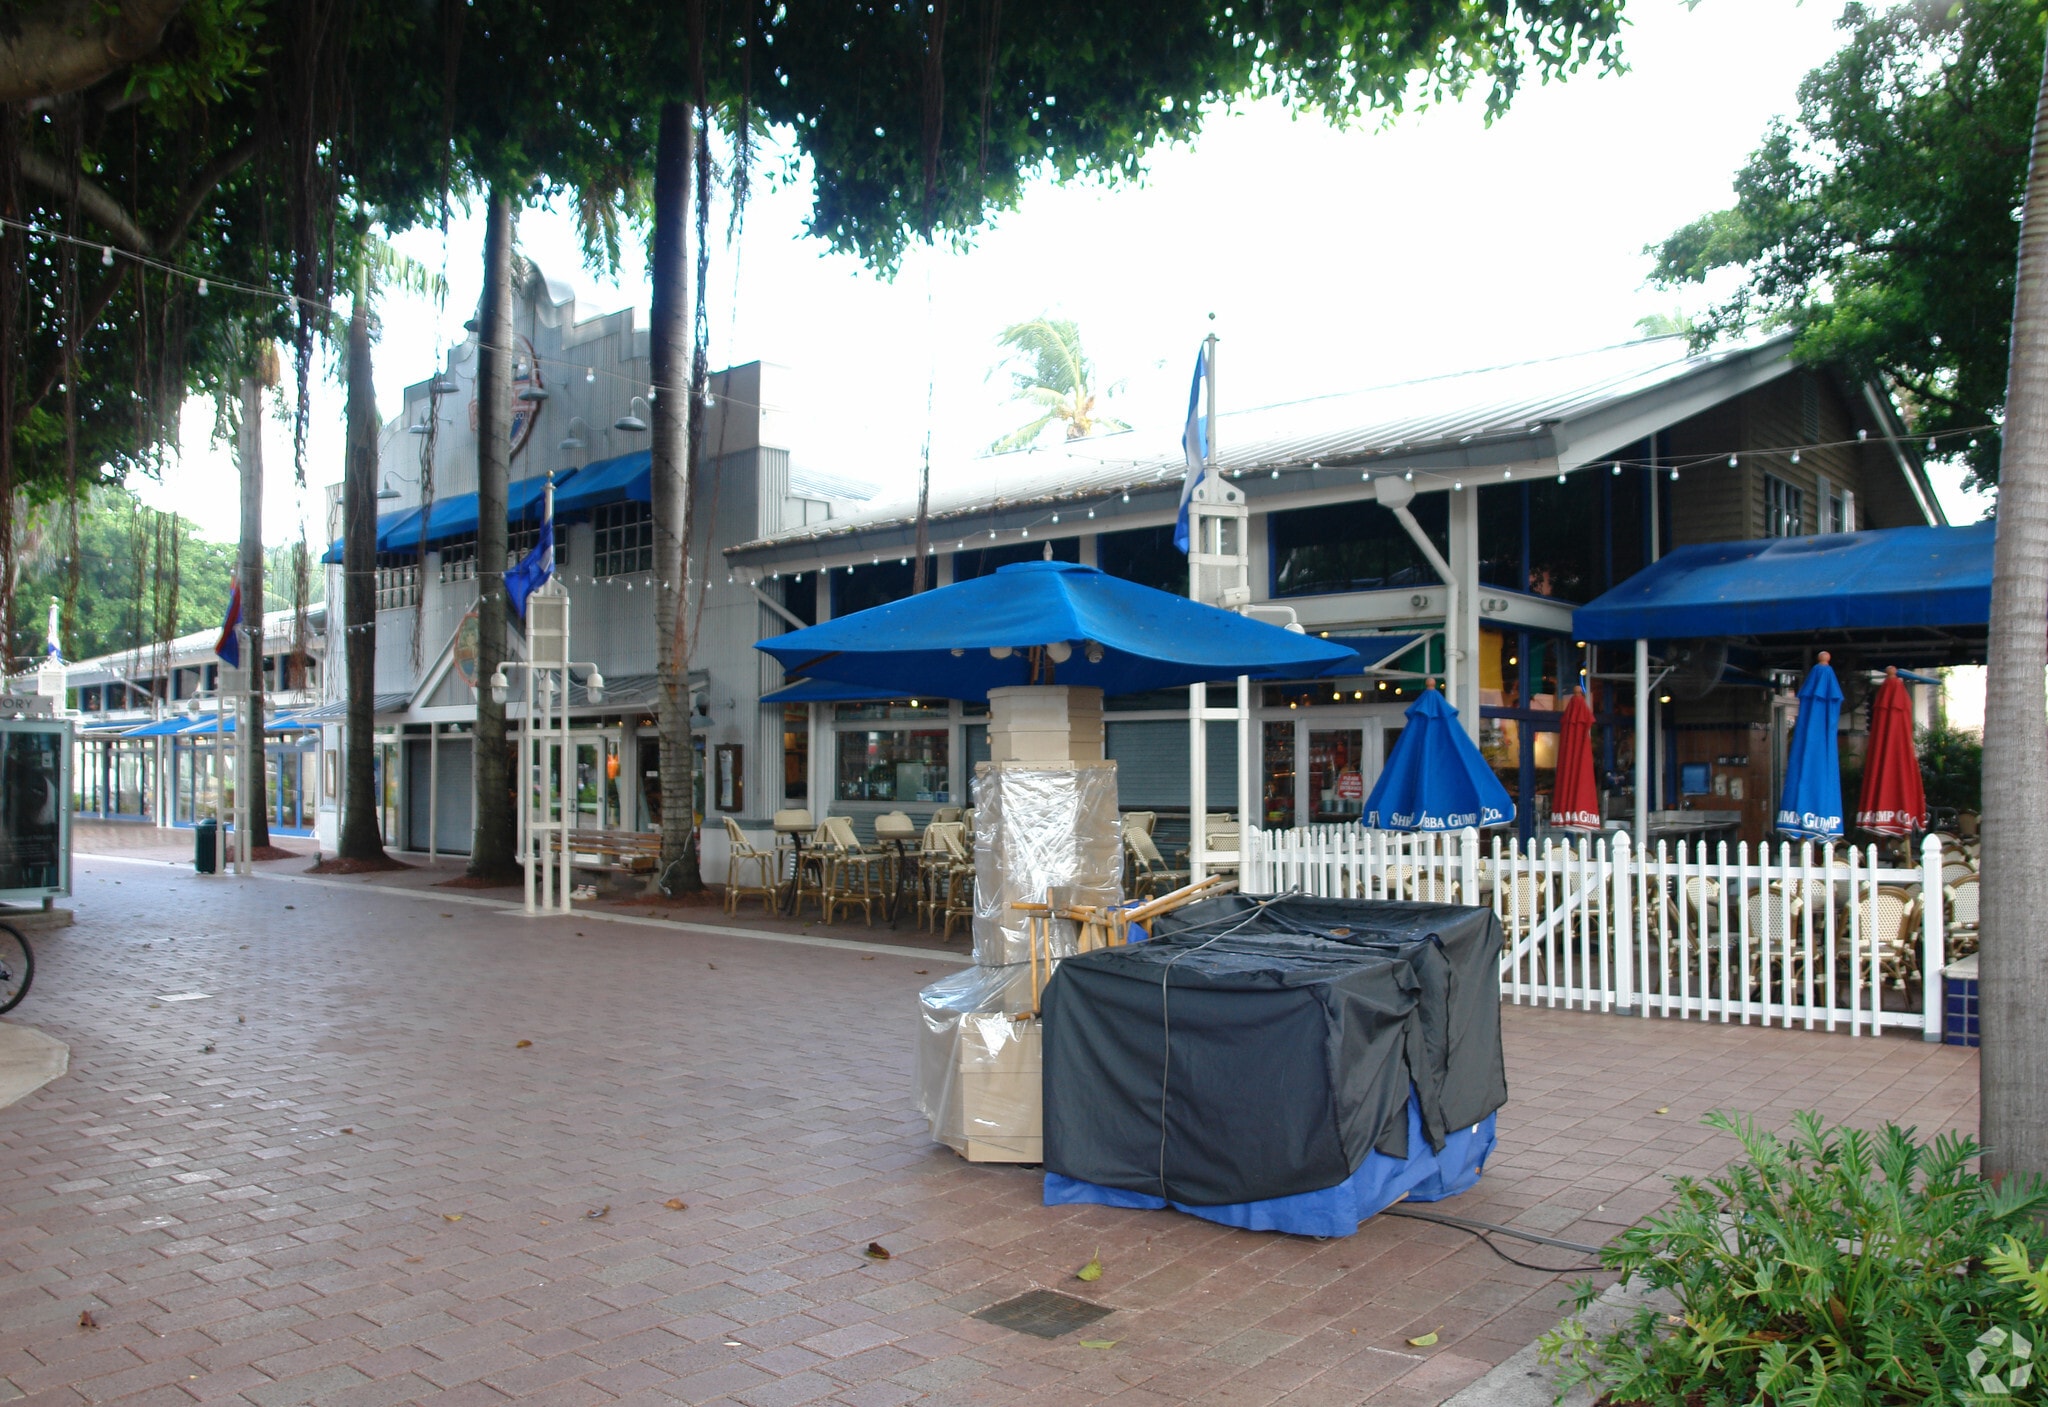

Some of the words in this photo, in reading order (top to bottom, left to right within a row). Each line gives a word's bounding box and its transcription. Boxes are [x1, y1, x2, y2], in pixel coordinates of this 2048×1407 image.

[0, 698, 32, 709] ORY
[1423, 817, 1446, 829] BBA
[1578, 810, 1600, 825] GUM
